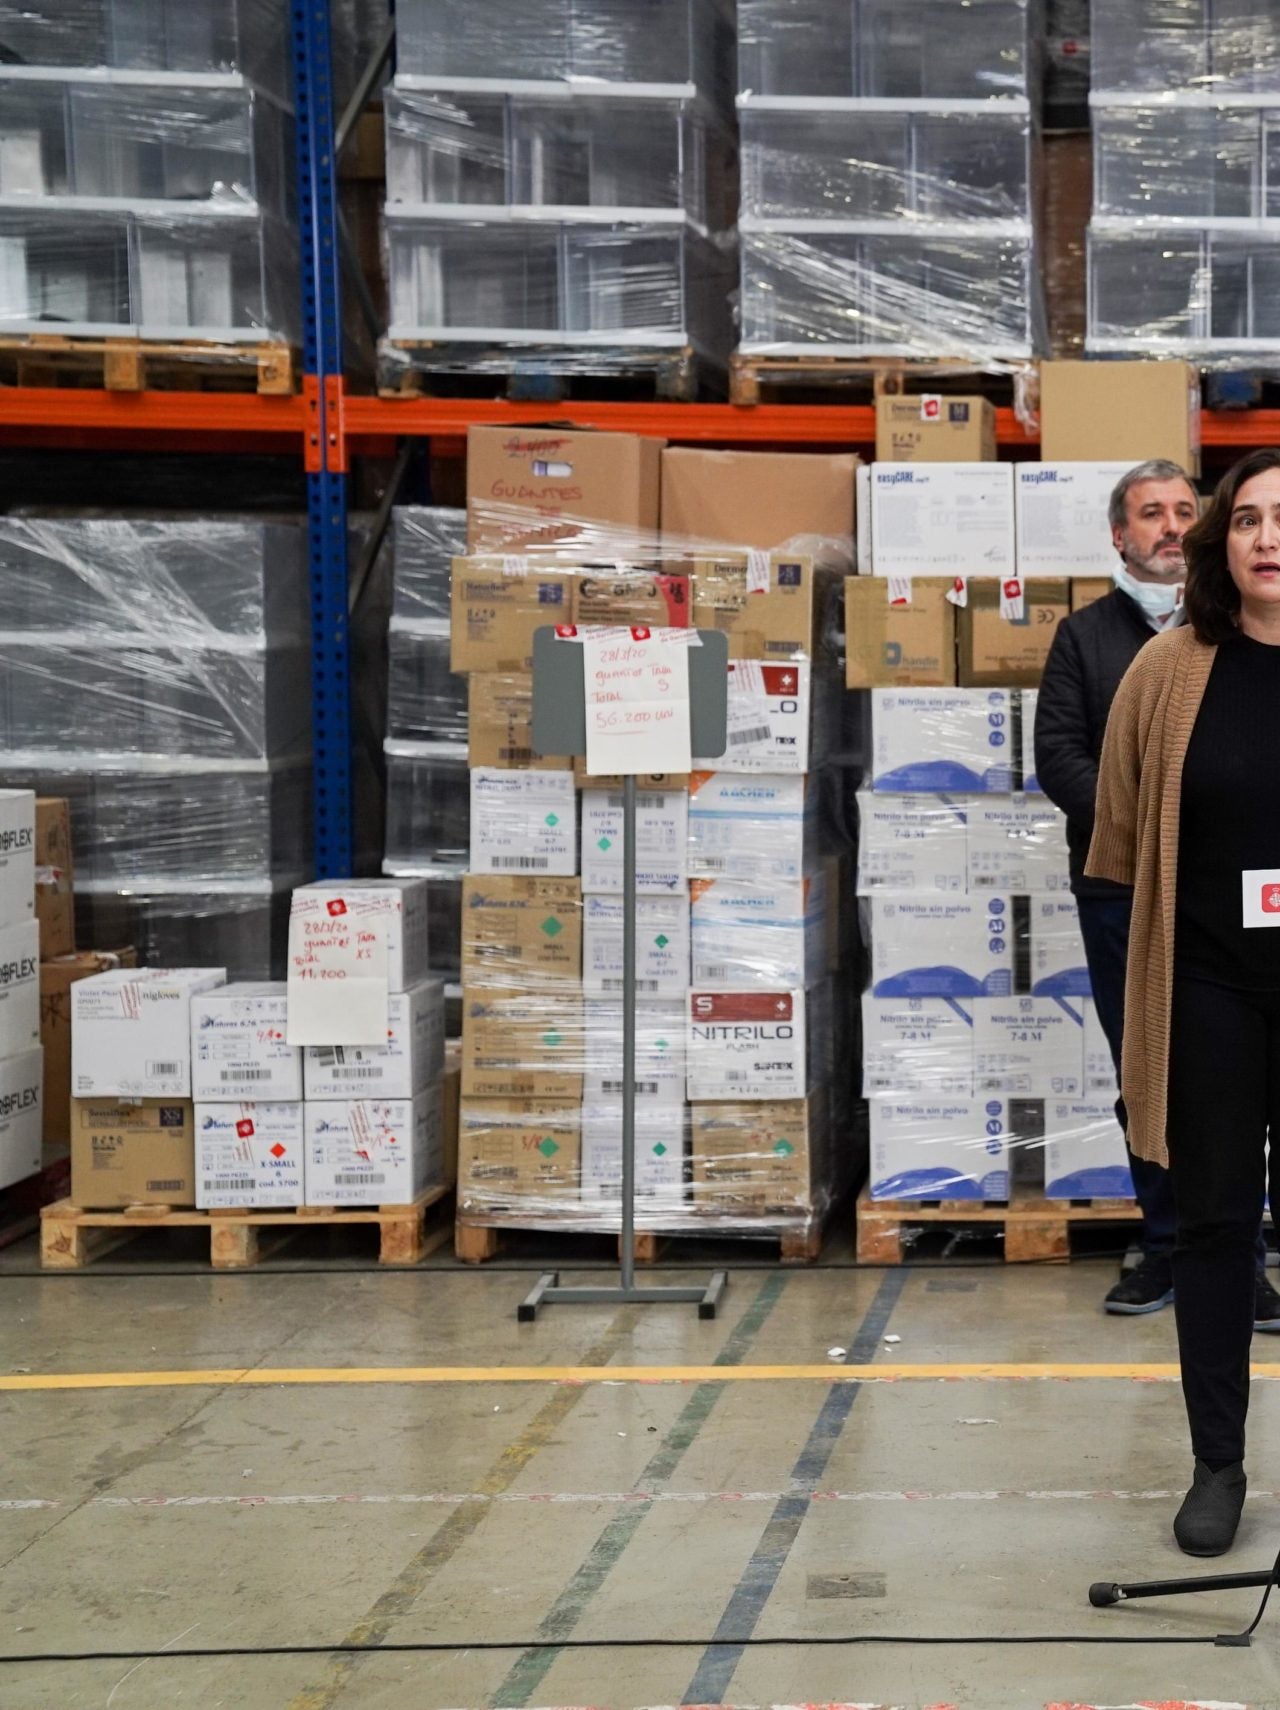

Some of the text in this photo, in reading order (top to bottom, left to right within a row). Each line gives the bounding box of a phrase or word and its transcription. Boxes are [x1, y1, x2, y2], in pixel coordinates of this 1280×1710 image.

[899, 905, 971, 915] Nitrilo sin polvo
[143, 990, 181, 1002] nigloves
[696, 996, 713, 1013] S
[990, 1014, 1063, 1025] Nitrilo sin polvo
[692, 1026, 793, 1040] NITRILO
[1011, 1032, 1042, 1041] 7-8 M
[896, 1106, 923, 1114] Nitrilo
[943, 1107, 968, 1116] polvo
